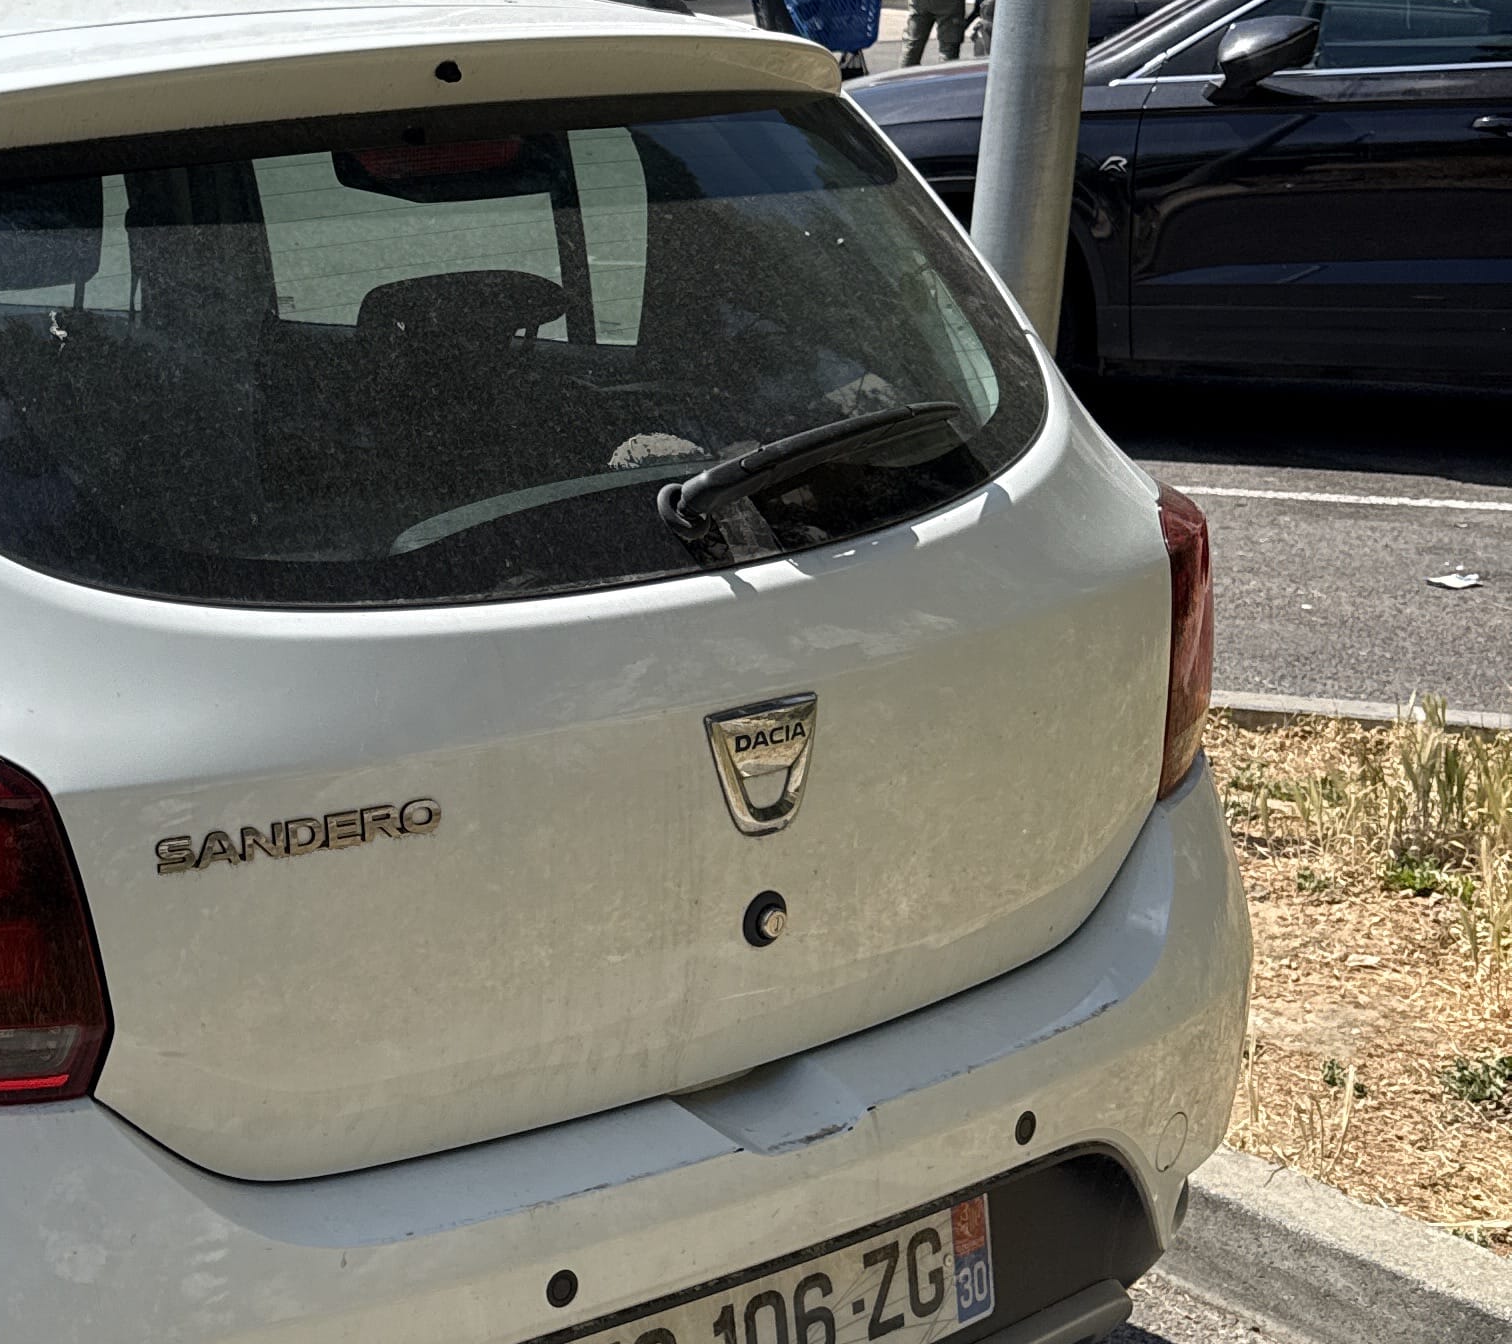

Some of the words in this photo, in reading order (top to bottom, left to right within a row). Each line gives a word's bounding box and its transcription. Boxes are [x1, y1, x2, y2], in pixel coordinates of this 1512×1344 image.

[734, 722, 806, 753] DACIA
[155, 798, 442, 874] SANDERO
[958, 1260, 987, 1309] 30
